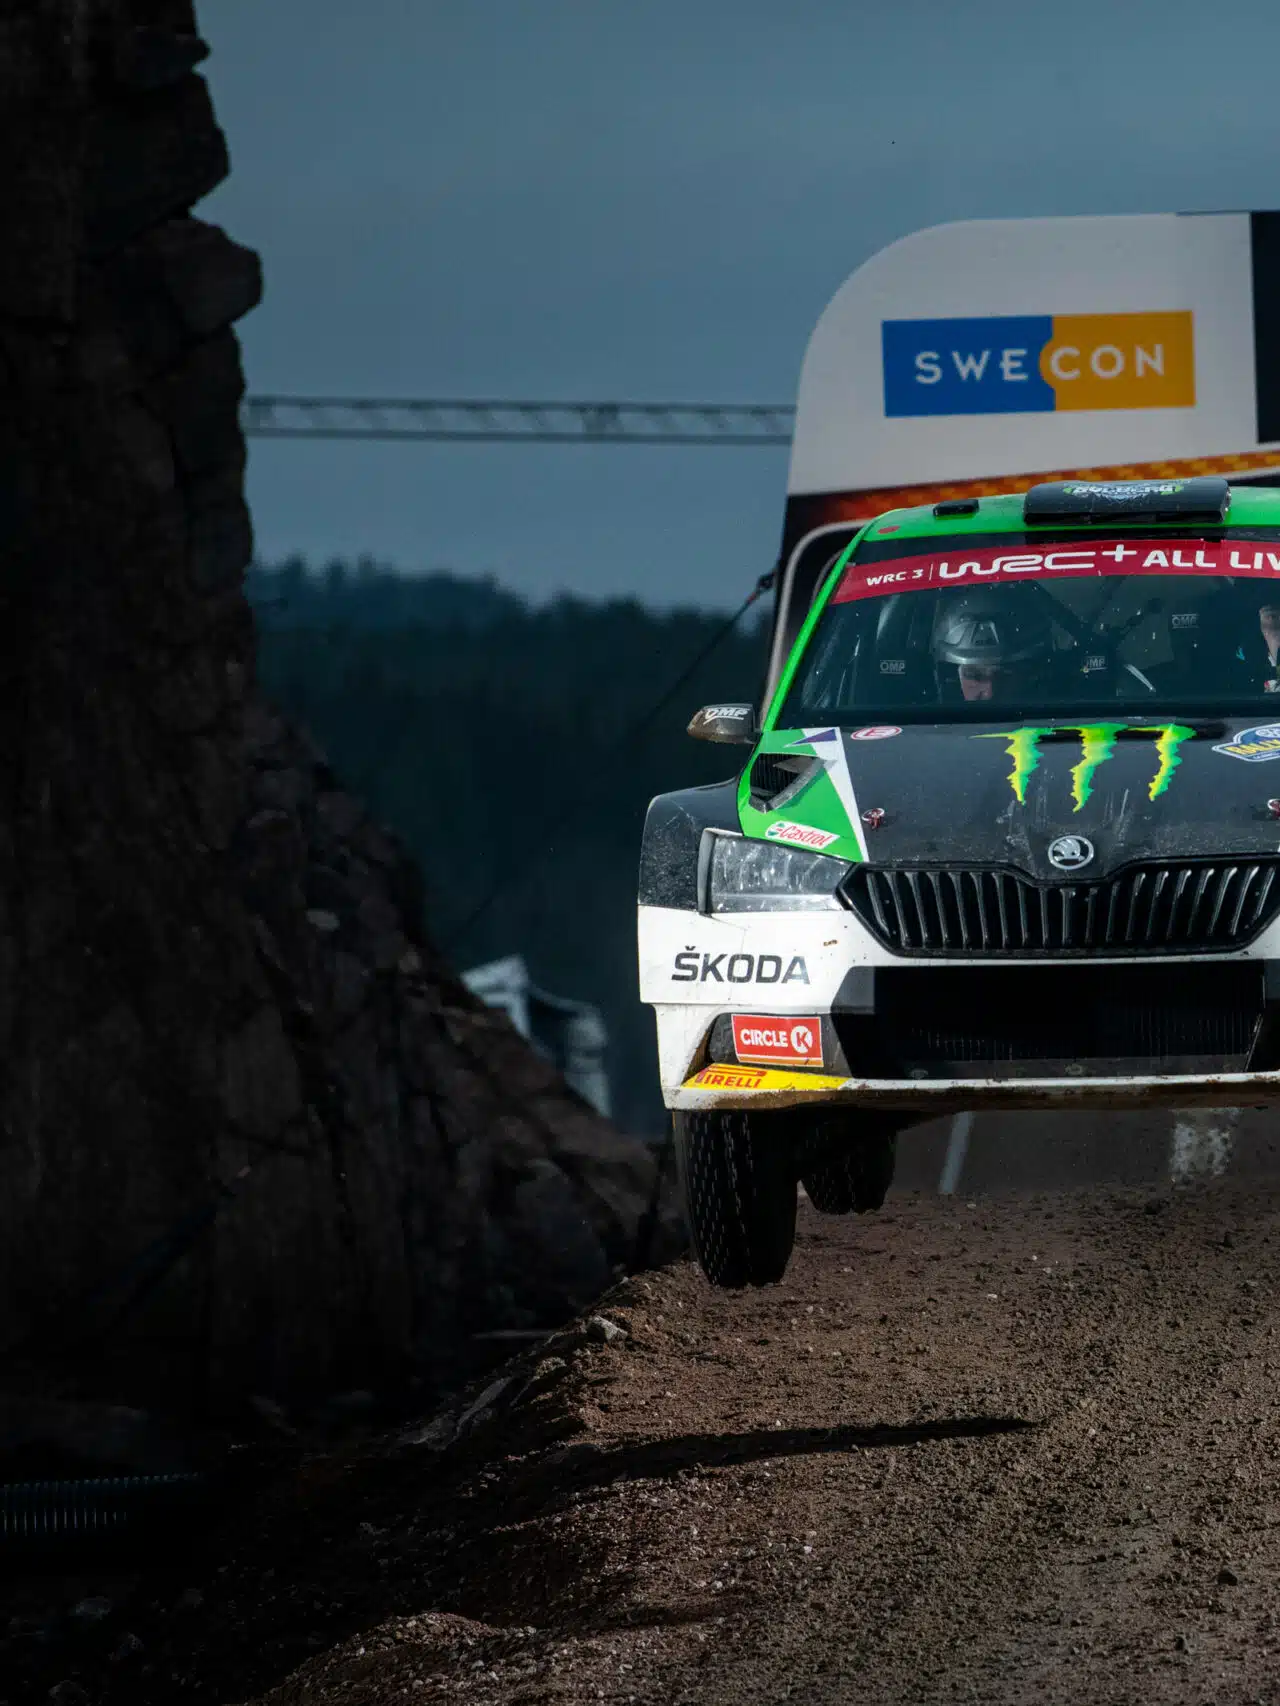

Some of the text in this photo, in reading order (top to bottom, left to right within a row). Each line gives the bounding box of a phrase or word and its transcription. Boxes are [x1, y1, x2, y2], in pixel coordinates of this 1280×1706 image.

[914, 343, 1166, 385] SWECON
[866, 571, 907, 587] WRC
[911, 568, 924, 580] 3
[1142, 549, 1217, 569] ALL
[704, 707, 750, 721] OMP
[780, 825, 833, 846] Castrol
[670, 945, 811, 985] ŠKODA
[740, 1028, 789, 1048] CIRCLE
[695, 1065, 767, 1088] PIRELLI
